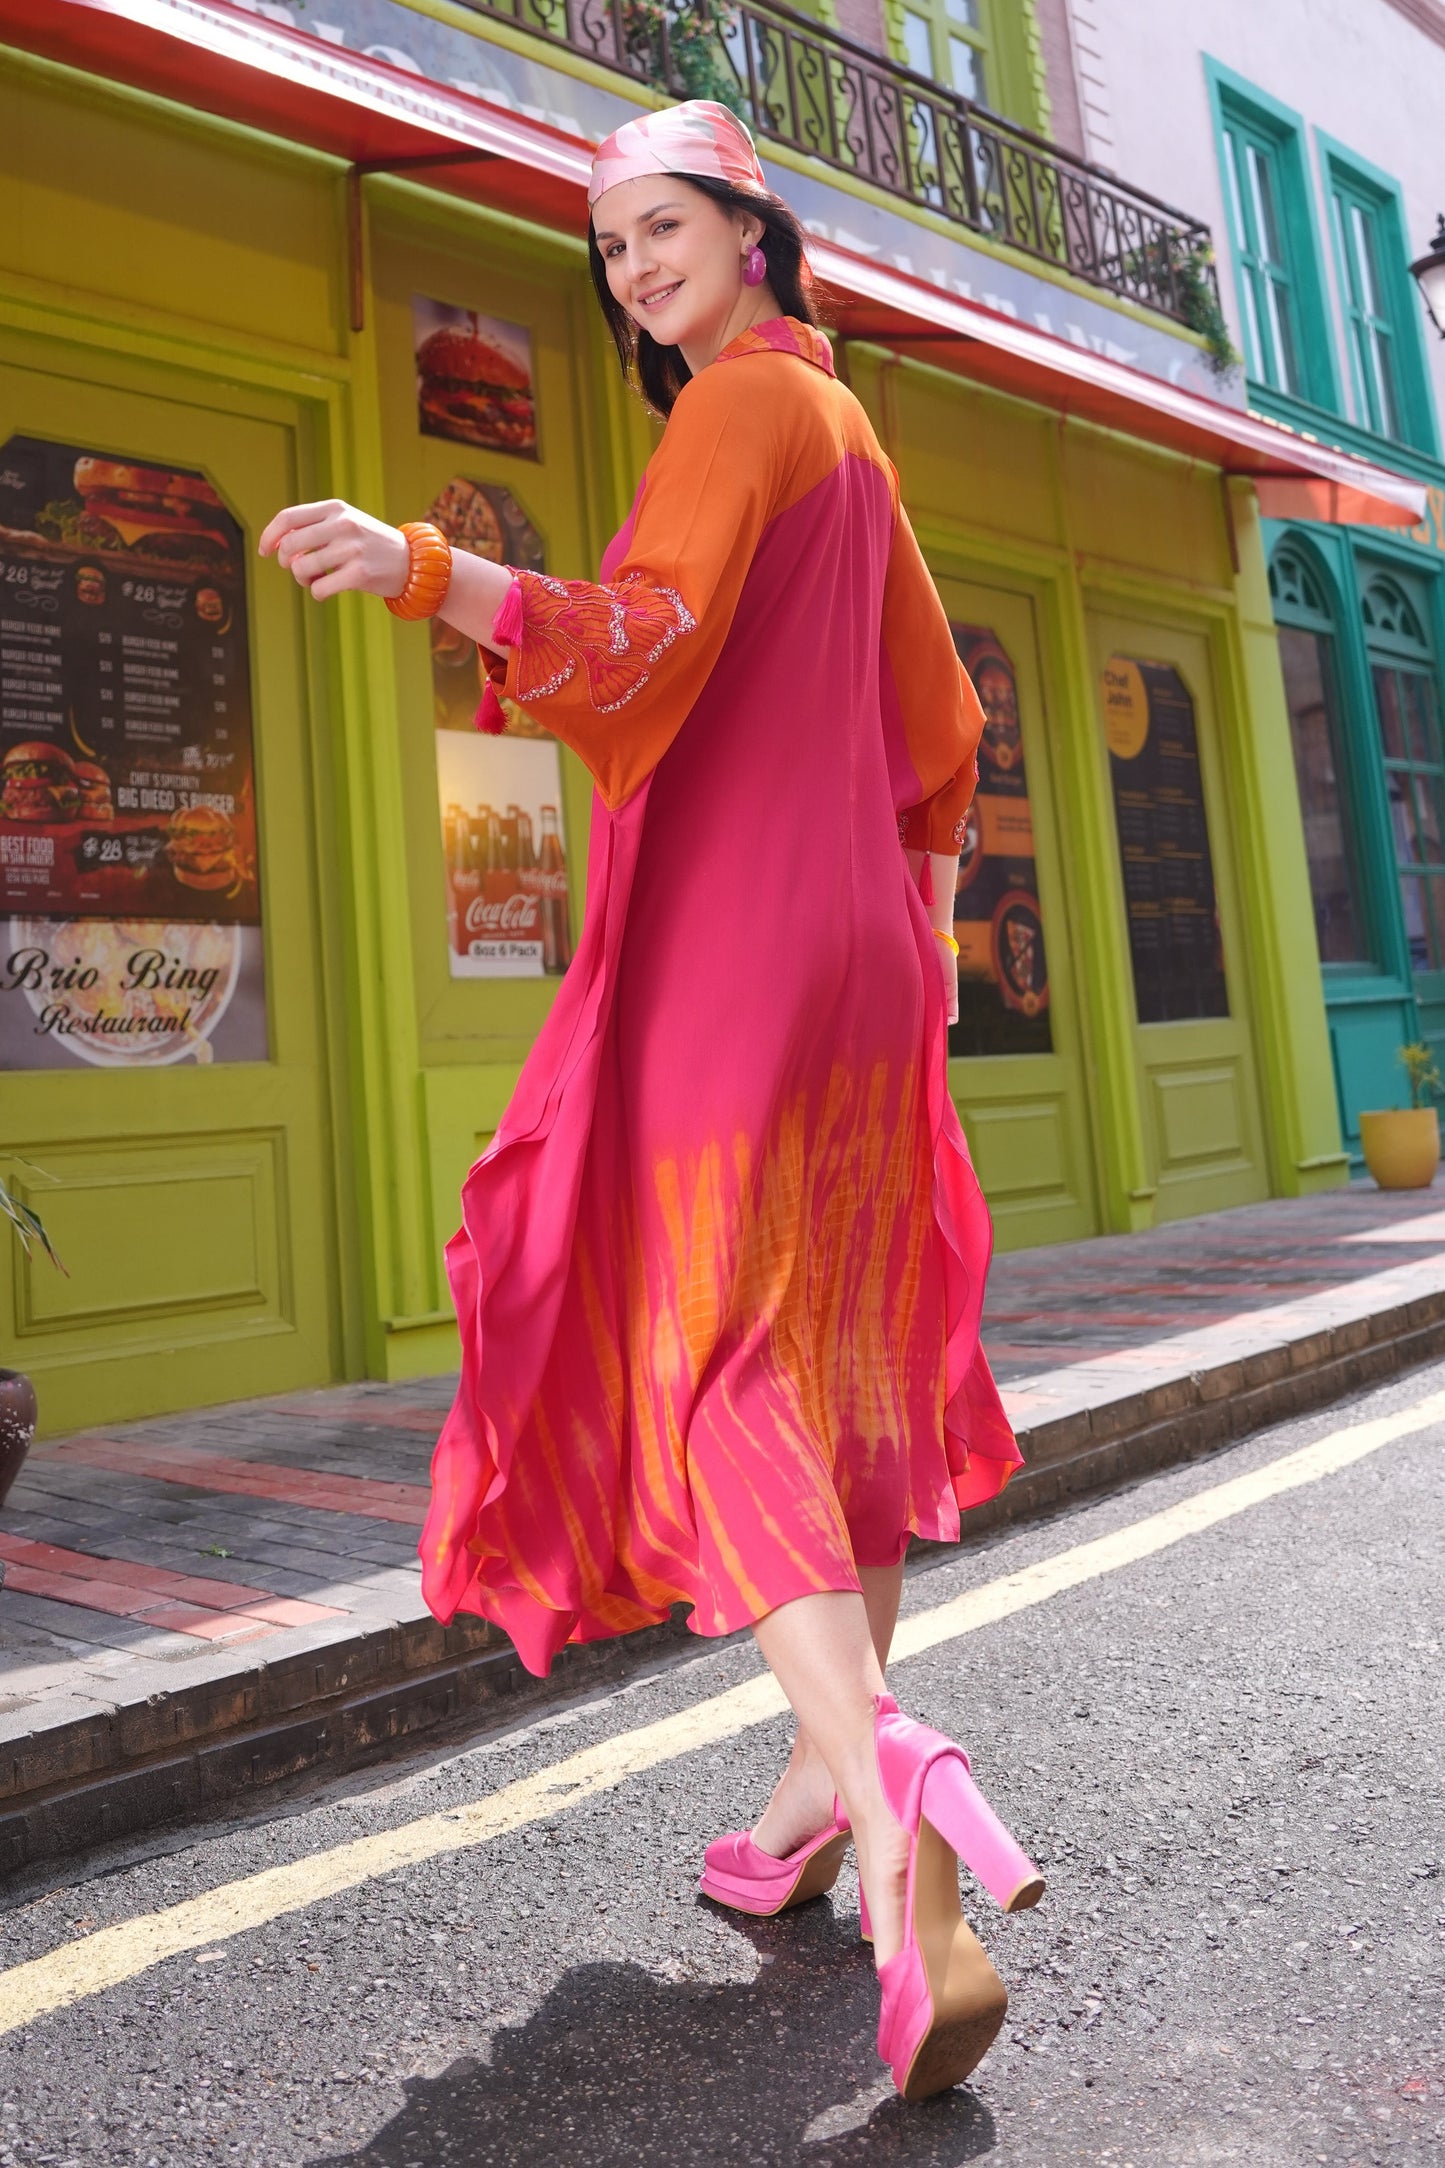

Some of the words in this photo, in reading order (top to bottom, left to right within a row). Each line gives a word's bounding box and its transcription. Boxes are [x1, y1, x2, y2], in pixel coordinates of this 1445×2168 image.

[1103, 670, 1129, 689] Chef
[1107, 690, 1132, 708] John
[117, 787, 138, 808] BIG
[140, 789, 175, 811] DIEGO
[190, 792, 235, 814] BURGER
[27, 836, 54, 856] FOOD
[499, 943, 507, 956] 6
[510, 943, 538, 957] Pack
[0, 946, 98, 993] Brio
[120, 949, 220, 1001] Bing
[34, 1004, 191, 1036] Restaurant
